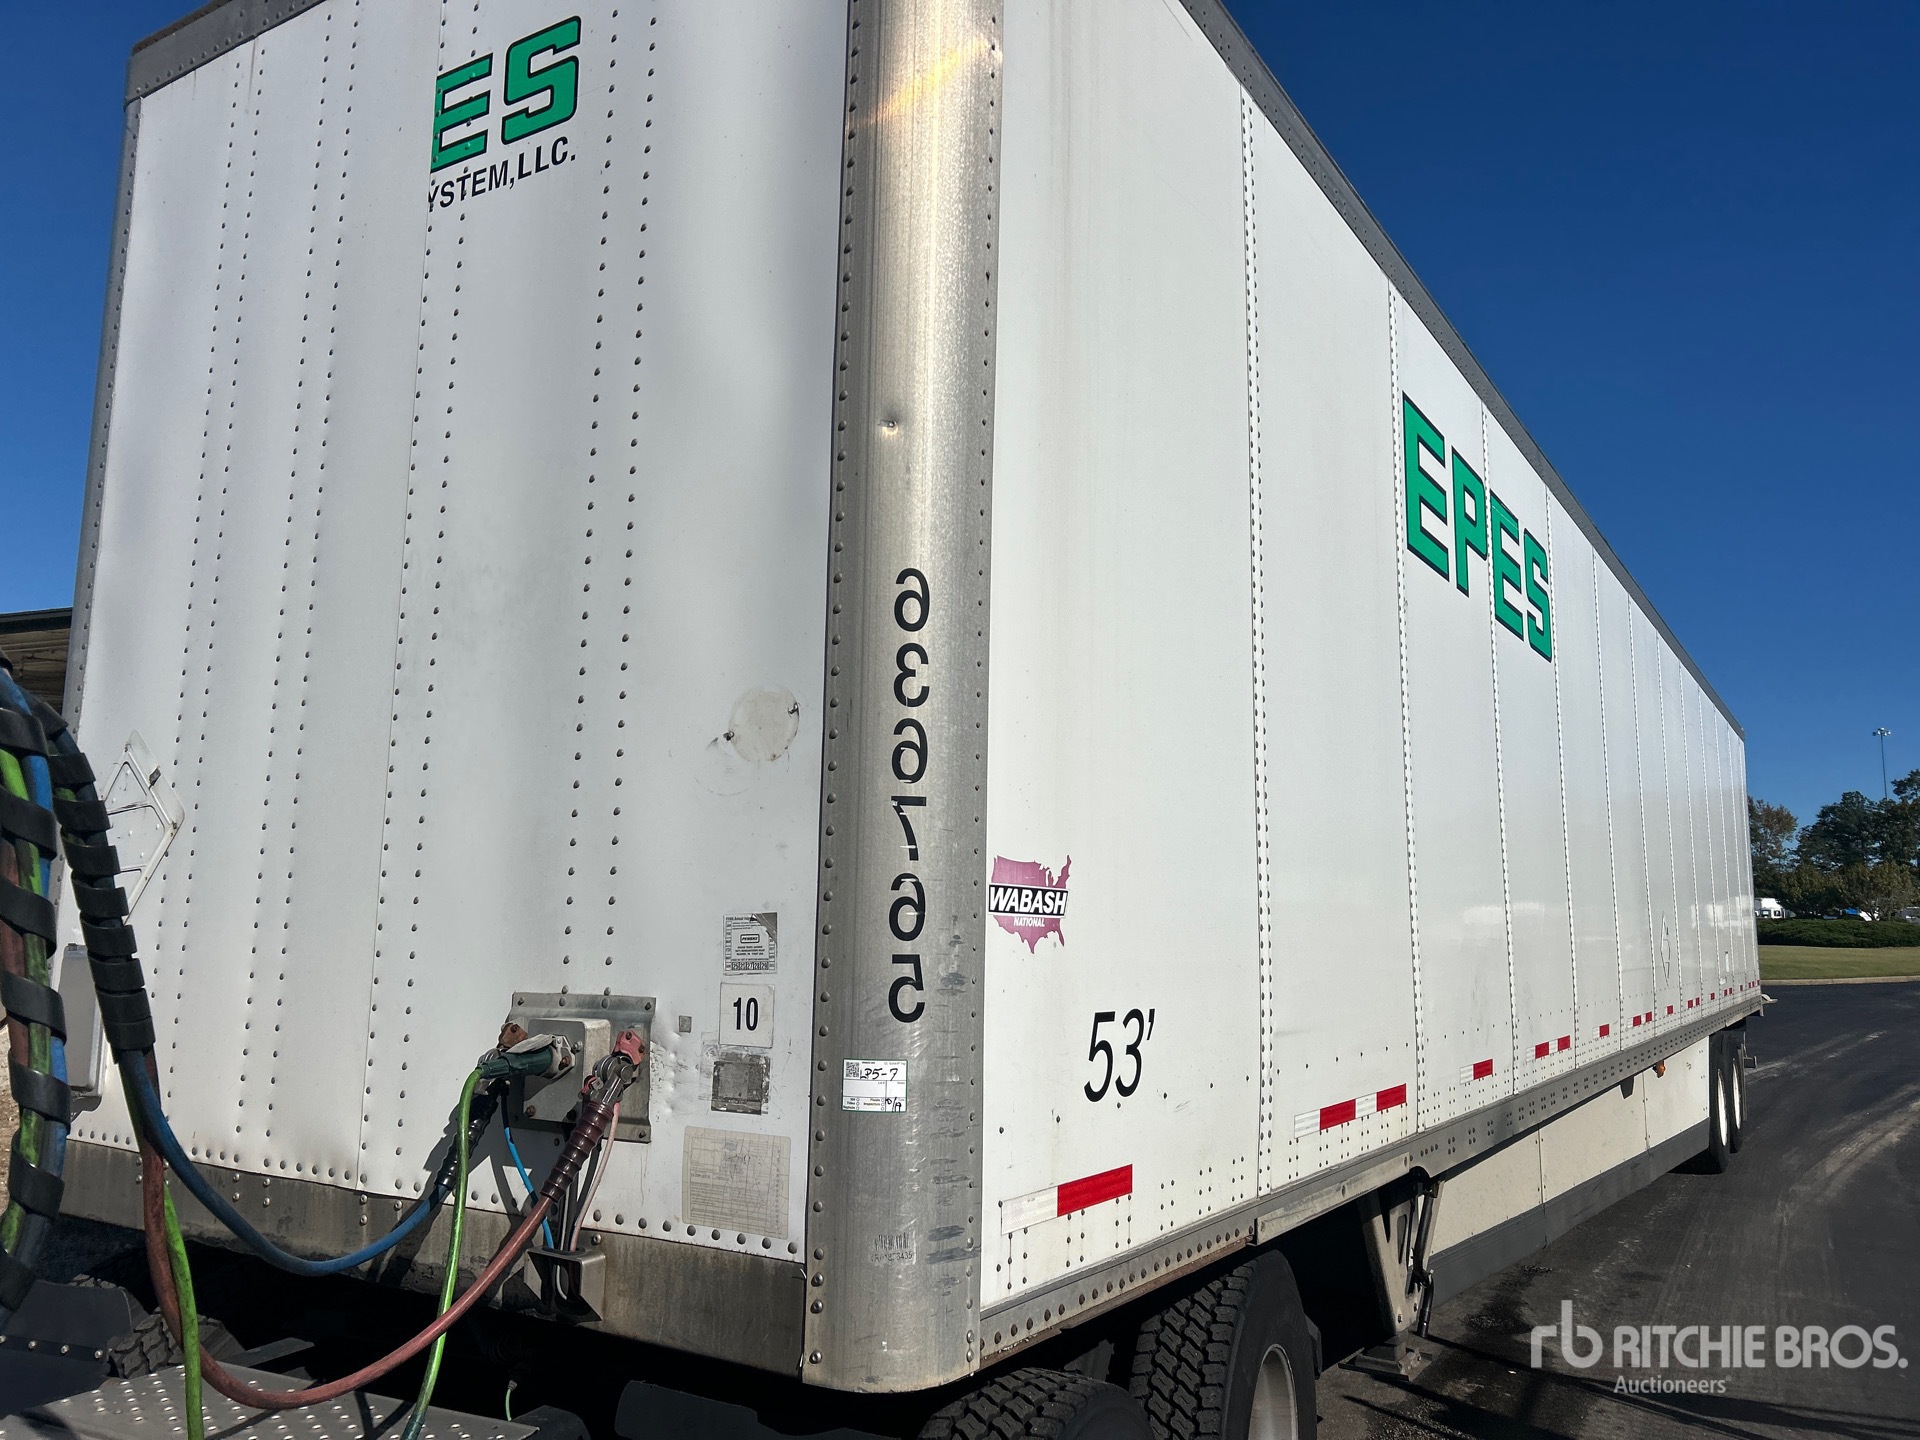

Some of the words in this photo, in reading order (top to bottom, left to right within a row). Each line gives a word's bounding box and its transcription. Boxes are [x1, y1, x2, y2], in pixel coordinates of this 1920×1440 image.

[430, 15, 582, 173] ES
[1402, 390, 1552, 663] EPES
[989, 886, 1068, 915] WABASH
[1013, 916, 1046, 927] NATIONAL
[732, 996, 759, 1031] 10
[1083, 1008, 1156, 1103] 53'
